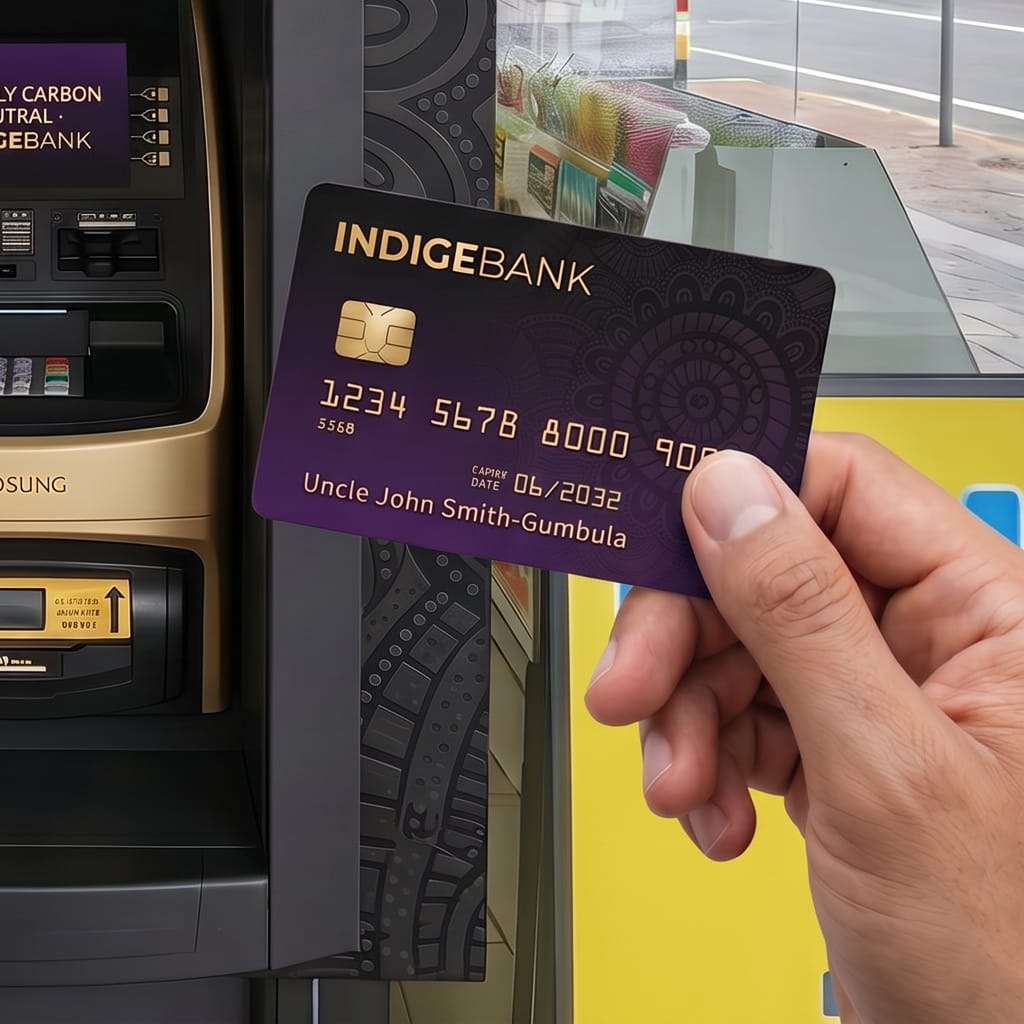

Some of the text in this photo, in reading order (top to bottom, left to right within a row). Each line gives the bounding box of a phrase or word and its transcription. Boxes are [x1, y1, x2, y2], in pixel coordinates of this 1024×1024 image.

[22, 85, 102, 103] CARBON
[333, 221, 596, 297] INDIGEBANK
[317, 417, 356, 435] 5568
[319, 378, 407, 420] 1234
[541, 418, 630, 459] 8000
[470, 477, 501, 492] DATE
[513, 472, 622, 511] 06/2032
[303, 471, 628, 550] Uncle John Smith-Gumbula
